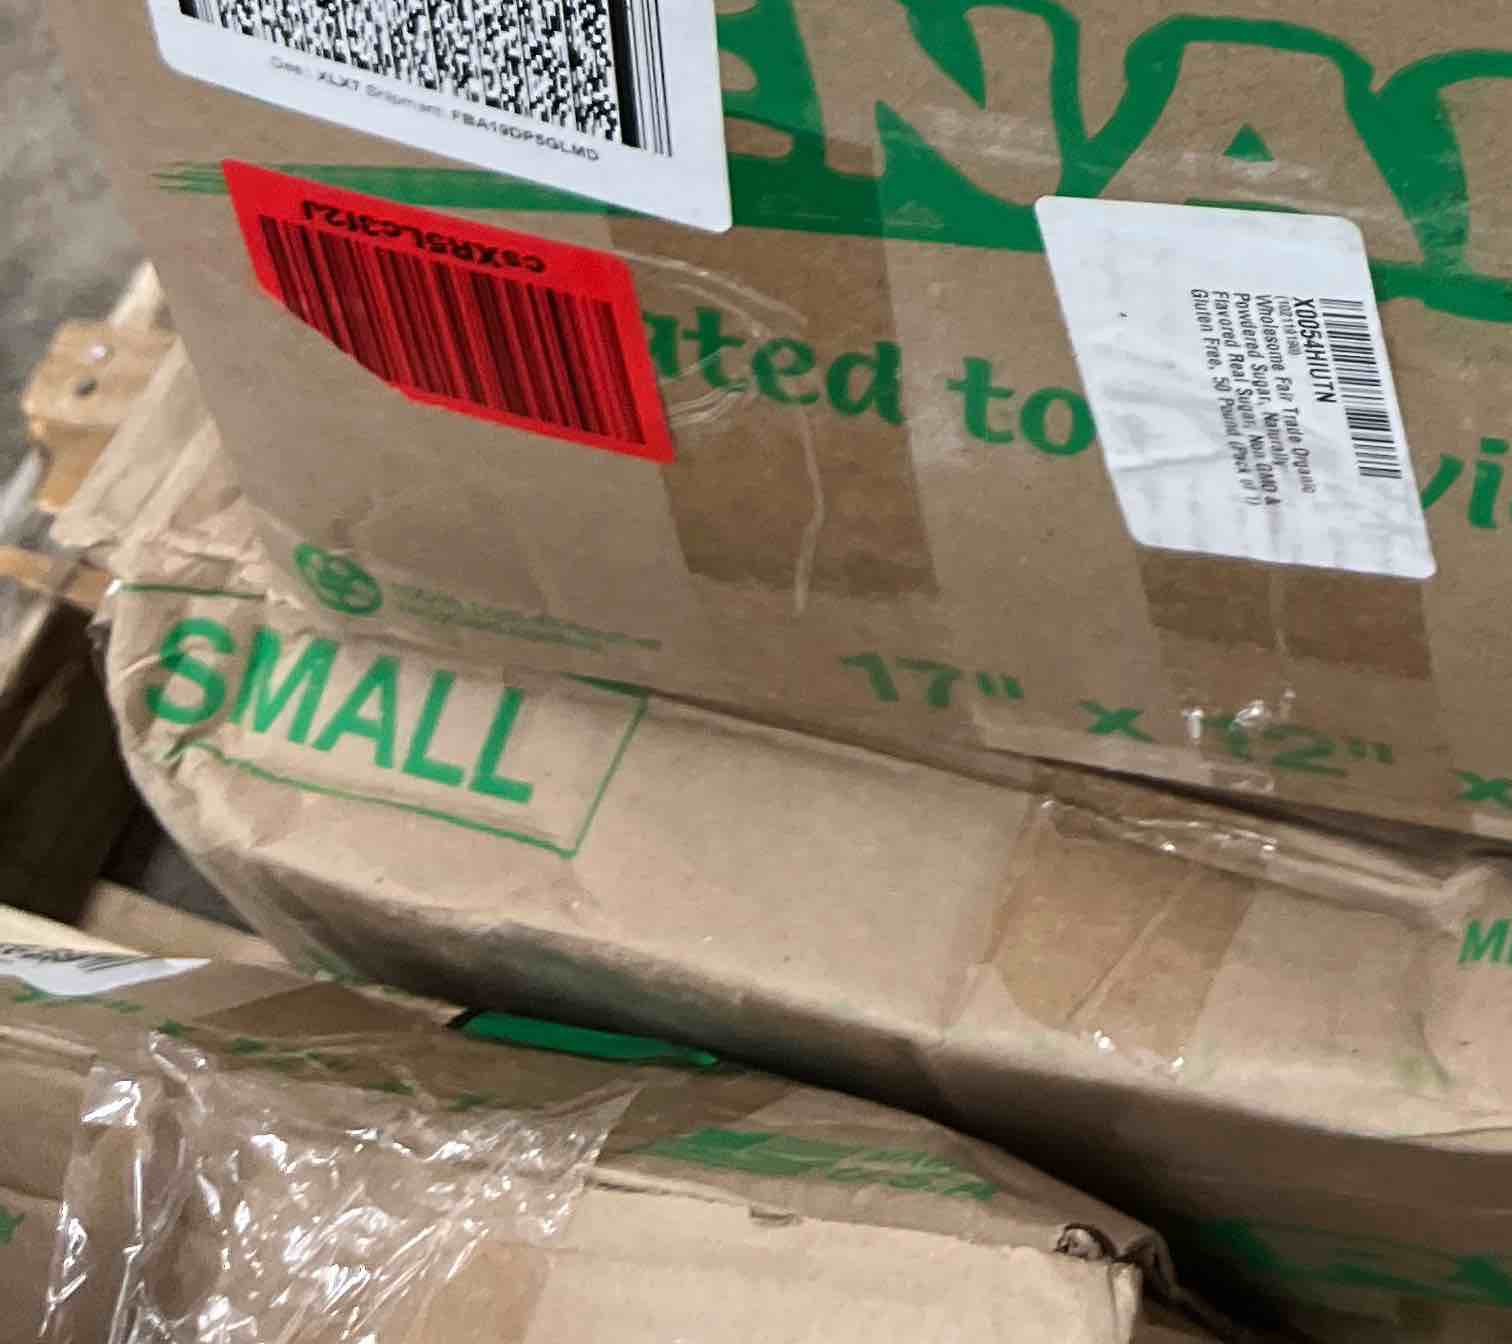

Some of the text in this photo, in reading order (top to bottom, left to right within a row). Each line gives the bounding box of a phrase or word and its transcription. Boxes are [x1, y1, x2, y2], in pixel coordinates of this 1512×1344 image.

[1190, 287, 1216, 333] Gluten
[1211, 289, 1237, 350] Flavored
[1229, 352, 1246, 382] Real
[1233, 291, 1261, 359] Powdered
[1252, 364, 1273, 406] Sugar,
[1293, 294, 1338, 405] X0054HIUTN
[945, 352, 1096, 457] to
[1212, 374, 1227, 393] 50
[1218, 397, 1239, 440] Pound
[1254, 293, 1286, 372] Wholesome
[1275, 375, 1295, 402] Fair
[1285, 405, 1303, 445] Trade
[144, 614, 536, 806] SMALL
